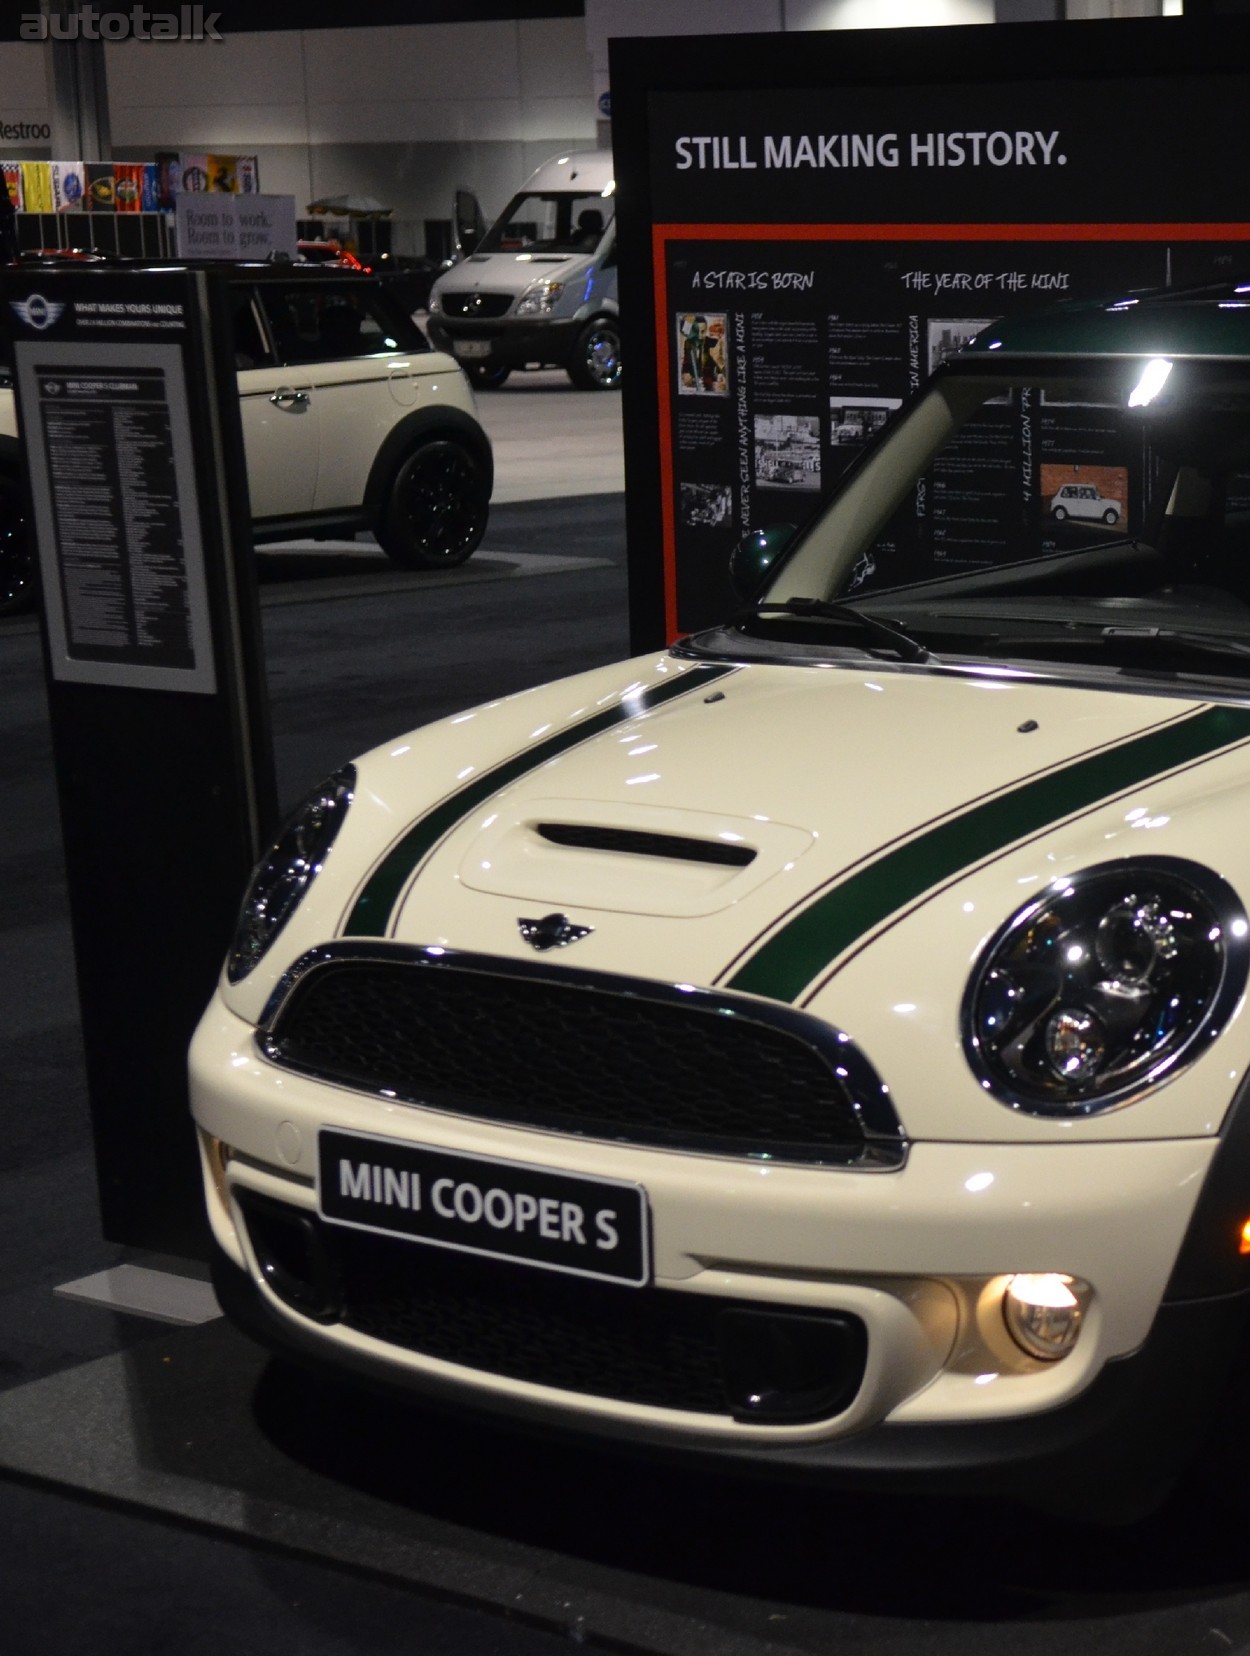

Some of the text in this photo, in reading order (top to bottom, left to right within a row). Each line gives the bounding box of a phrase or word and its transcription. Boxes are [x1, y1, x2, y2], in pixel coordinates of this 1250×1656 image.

[675, 131, 1068, 170] STILL MAKING HISTORY.
[692, 270, 815, 291] A STAR IS BORN
[900, 271, 1070, 296] THE YEAR OF THE MINI
[74, 303, 184, 315] WHAT MAKES YOURS UNIQUE
[735, 312, 746, 343] MINI
[908, 315, 920, 369] AMERICA
[736, 355, 747, 383] LIKE
[739, 447, 750, 483] SEEN
[1020, 415, 1032, 486] MILLION
[739, 485, 751, 526] NEVER
[339, 1158, 619, 1250] MINI COOPER S
